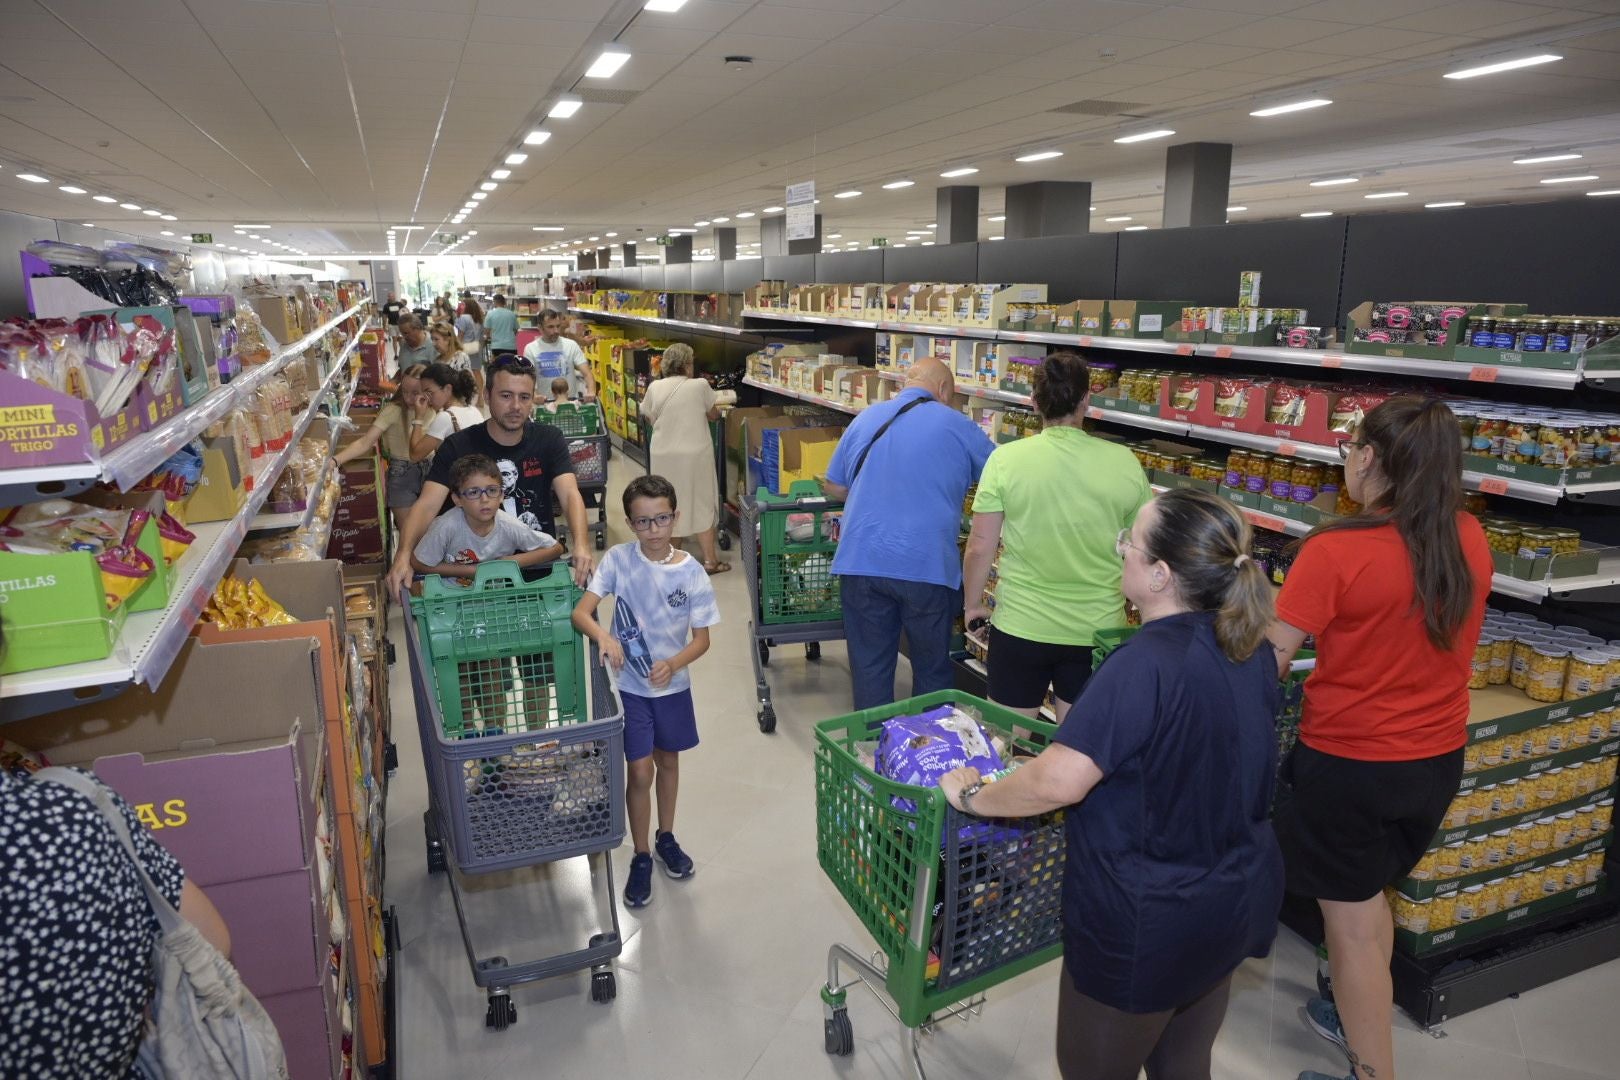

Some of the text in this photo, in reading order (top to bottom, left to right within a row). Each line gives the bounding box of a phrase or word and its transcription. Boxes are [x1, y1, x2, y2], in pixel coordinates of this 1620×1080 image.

[4, 408, 46, 422] MINI
[10, 440, 54, 453] TRIGO
[333, 528, 359, 540] Pipas
[0, 574, 57, 592] TILLAS
